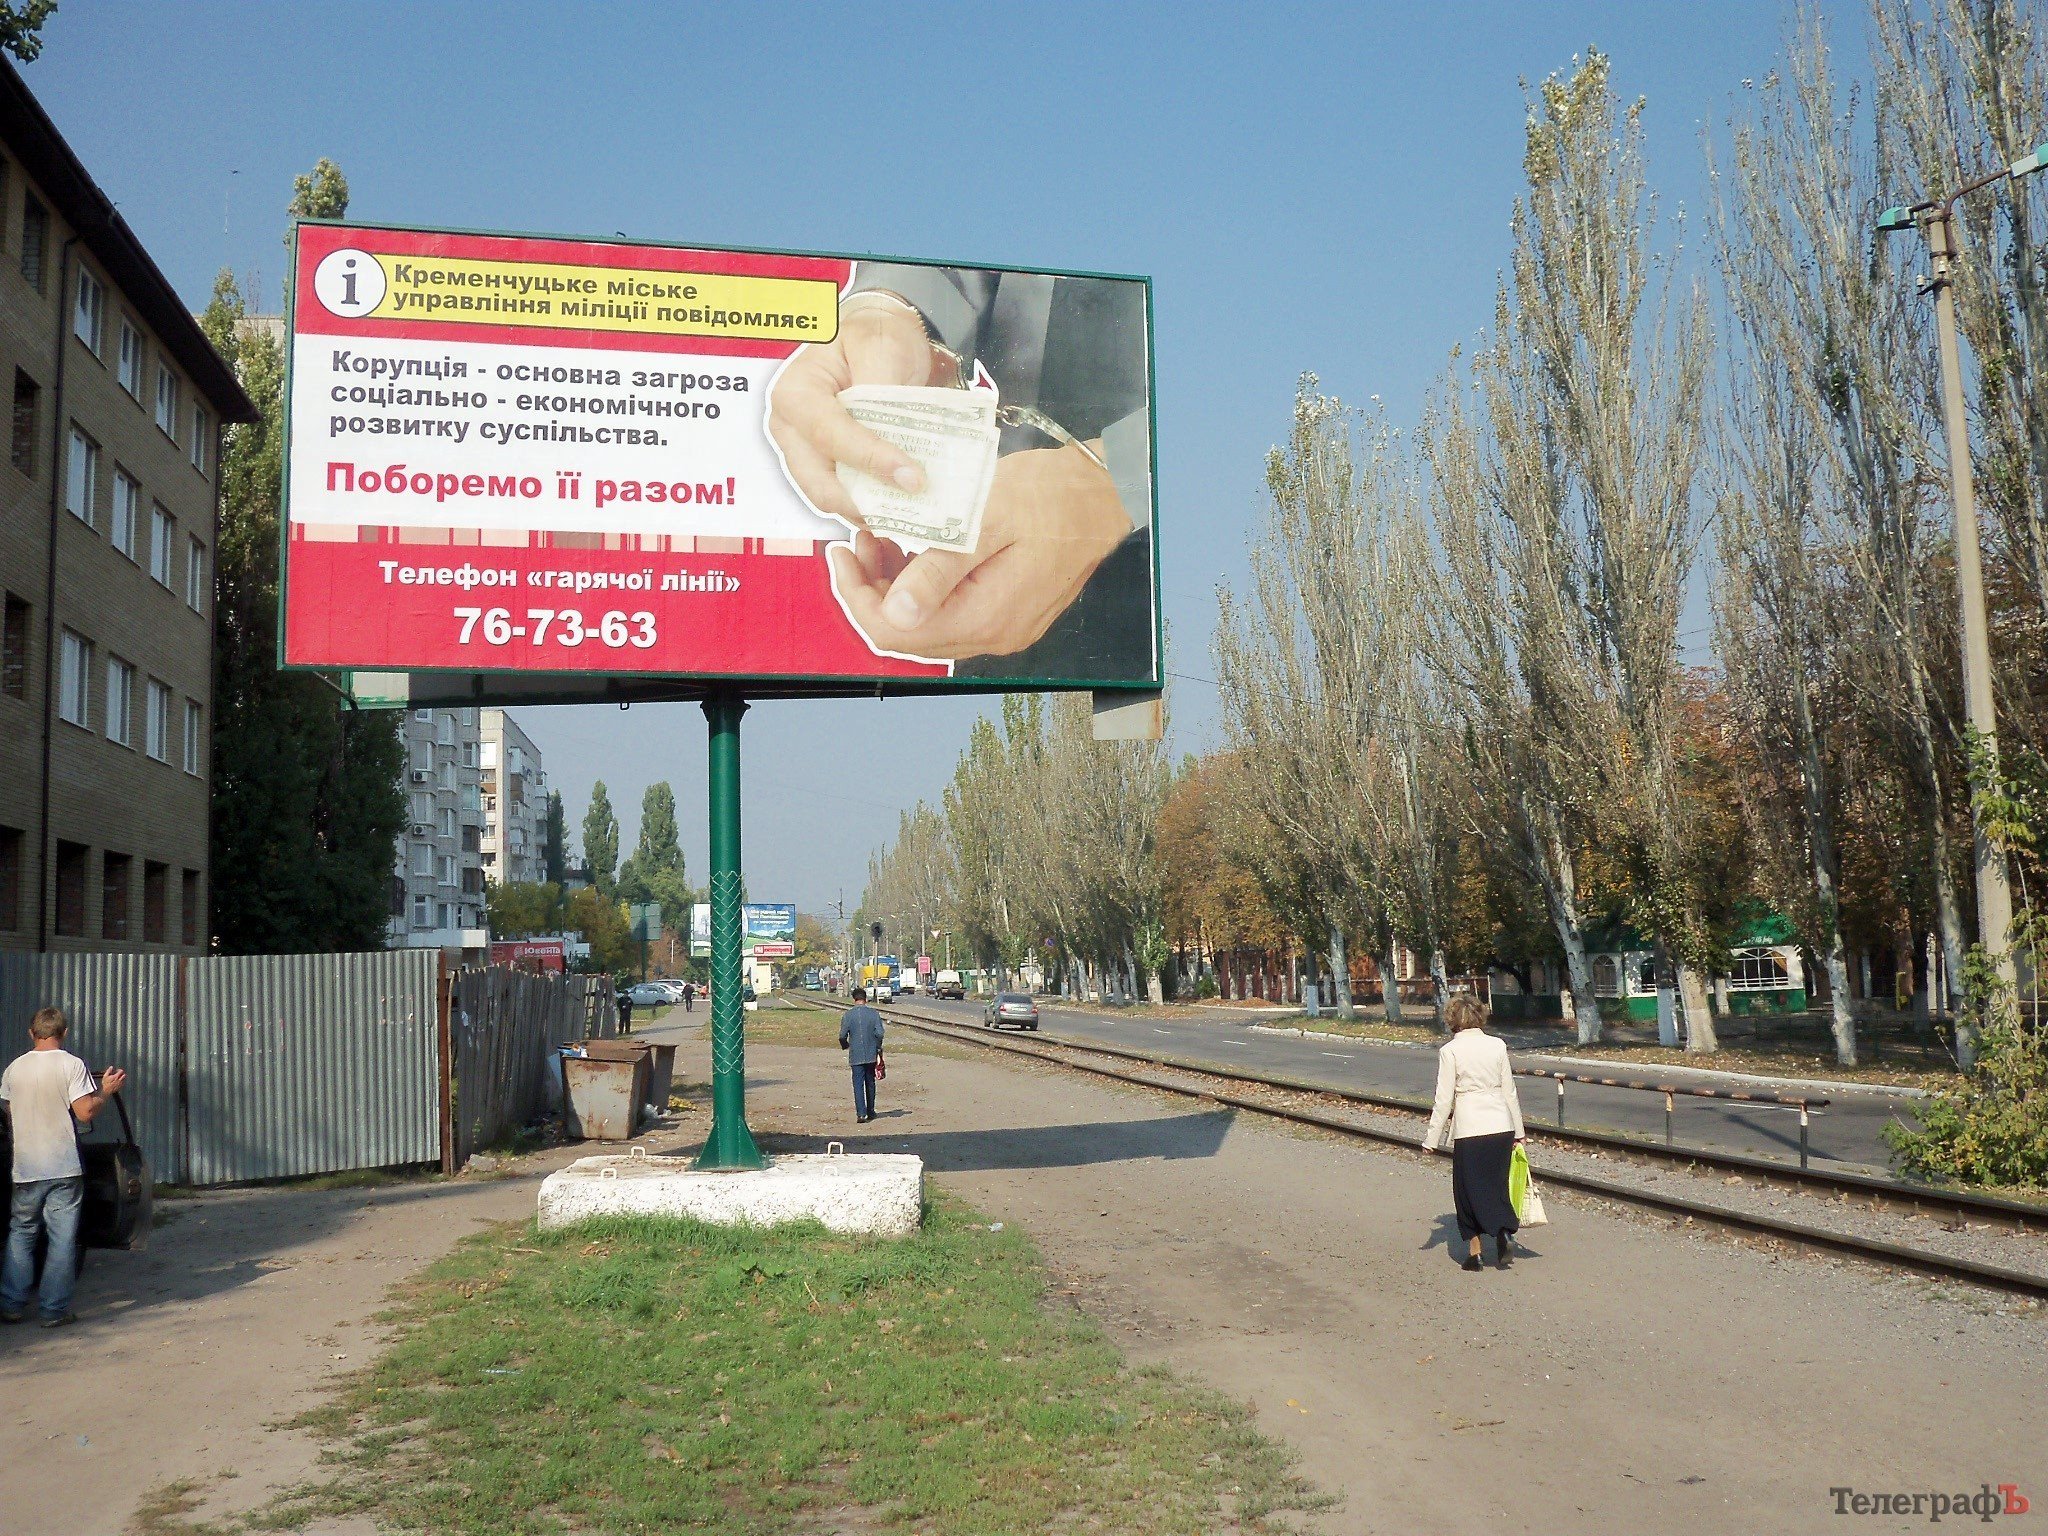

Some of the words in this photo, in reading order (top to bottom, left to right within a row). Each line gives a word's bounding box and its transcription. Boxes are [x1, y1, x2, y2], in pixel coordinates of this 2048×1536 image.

[395, 264, 597, 294] Кременчуцьке
[607, 278, 698, 300] міське
[393, 292, 551, 316] управління
[561, 298, 648, 323] міліції
[657, 305, 818, 330] повідомляє:
[332, 350, 468, 380] Корупція
[496, 364, 621, 386] основна
[632, 371, 749, 394] загроза
[331, 383, 488, 408] соціально
[516, 394, 721, 419] економічного
[330, 415, 470, 443] розвитку
[479, 420, 668, 446] суспільства.
[326, 462, 543, 502] Поборемо
[556, 471, 582, 499] її
[596, 477, 735, 508] разом!
[379, 560, 517, 590] Телефон
[527, 568, 653, 594] «гарячої
[660, 570, 741, 592] лінії»
[453, 606, 658, 648] 76-73-63
